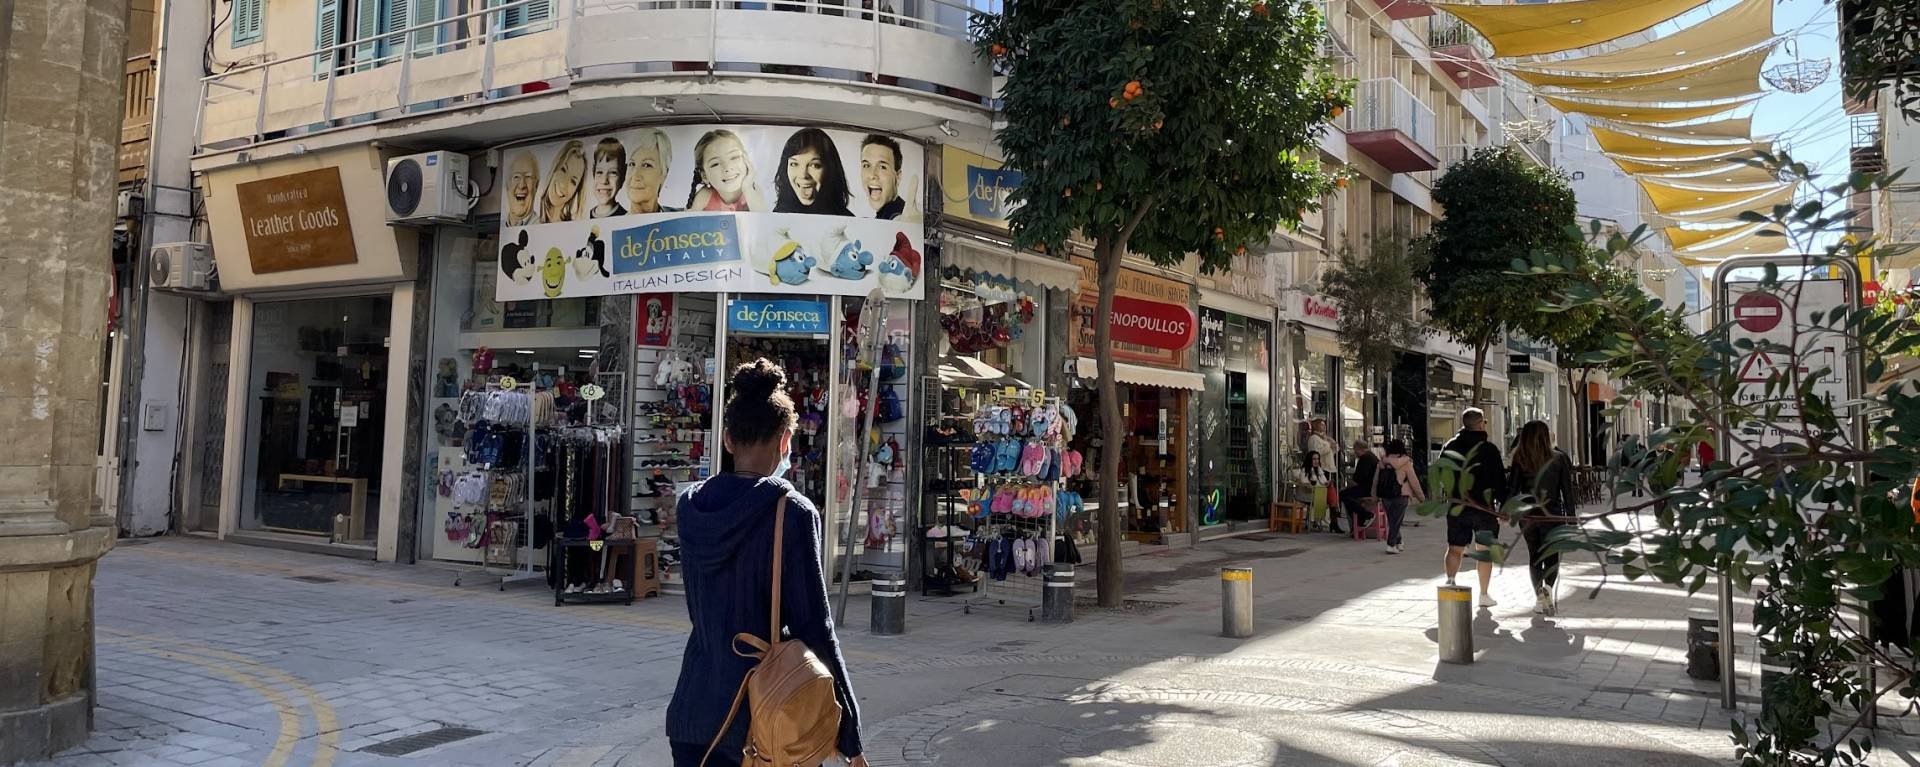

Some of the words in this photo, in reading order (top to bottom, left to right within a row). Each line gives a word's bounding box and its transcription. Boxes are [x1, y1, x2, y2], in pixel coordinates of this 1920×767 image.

[267, 188, 308, 203] Handcrafted
[250, 214, 294, 237] Leather
[299, 206, 339, 231] Goods
[652, 248, 724, 265] ITALY
[613, 274, 668, 292] ITALIAN
[673, 267, 742, 285] DESIGN
[766, 322, 819, 330] ITALY
[1109, 311, 1185, 335] ENOPOULLOS
[991, 390, 998, 402] 5
[1034, 391, 1043, 403] 5
